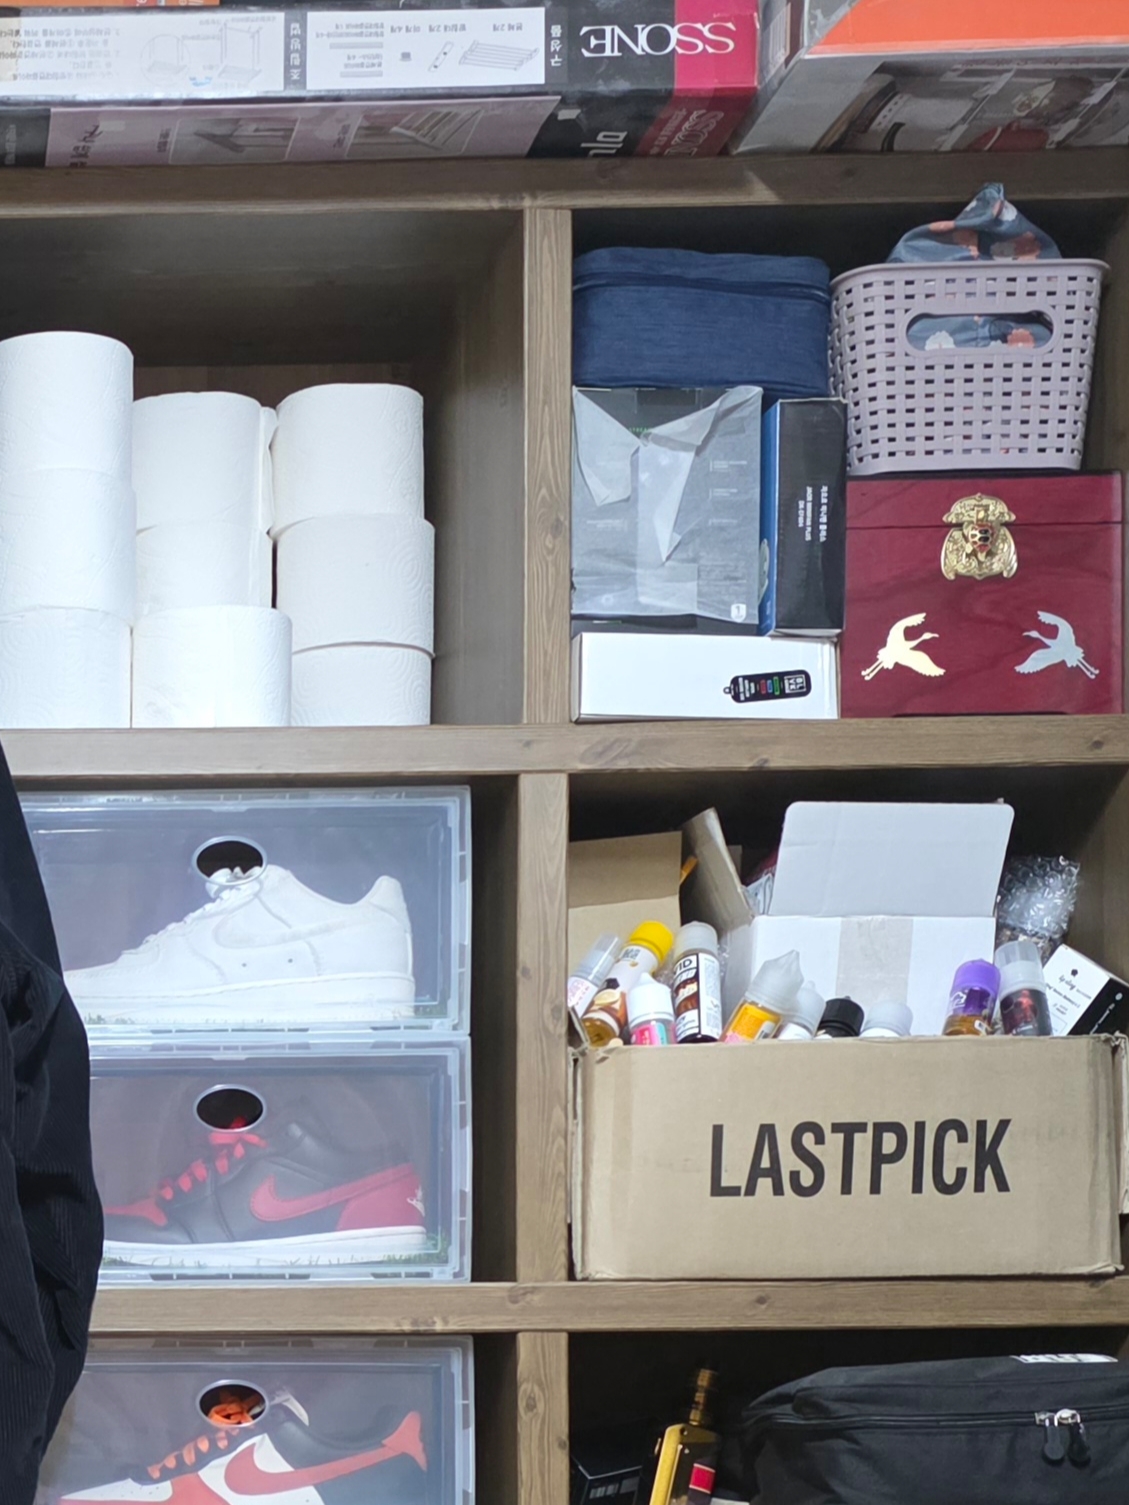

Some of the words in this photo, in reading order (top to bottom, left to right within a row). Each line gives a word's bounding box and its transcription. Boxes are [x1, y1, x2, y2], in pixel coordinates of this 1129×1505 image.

[550, 25, 563, 66] 구성품
[580, 22, 735, 58] SSONE
[709, 1118, 1012, 1198] LASTPICK
